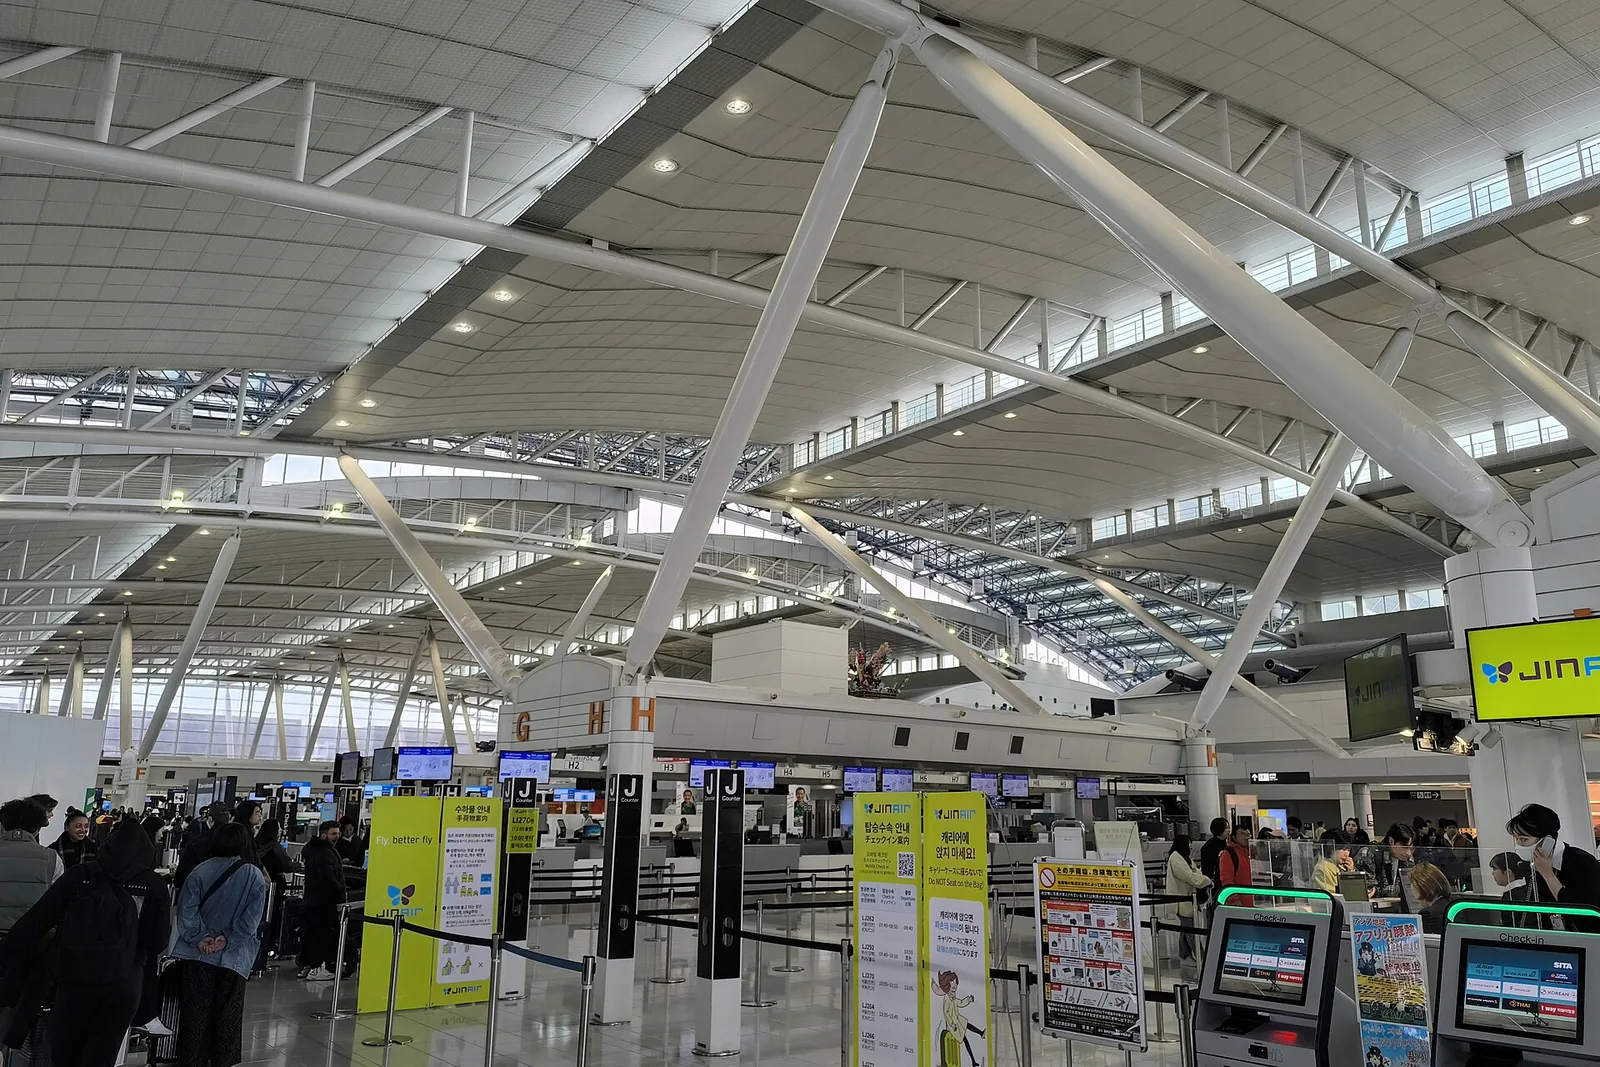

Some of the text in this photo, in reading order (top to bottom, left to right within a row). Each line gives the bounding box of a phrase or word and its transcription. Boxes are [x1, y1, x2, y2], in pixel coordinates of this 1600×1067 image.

[588, 700, 604, 735] H
[631, 696, 656, 732] H
[516, 711, 530, 742] G
[568, 761, 580, 770] H2
[664, 763, 674, 772] H3
[136, 767, 147, 780] F
[783, 768, 793, 777] H4
[505, 780, 511, 798] J
[518, 780, 531, 798] J
[609, 776, 616, 797] J
[623, 778, 636, 797] J
[706, 773, 714, 795] J
[725, 773, 738, 795] J
[348, 790, 359, 801] H
[455, 805, 491, 814] 수하물 안내
[874, 804, 912, 814] JINAIR
[943, 810, 977, 820] JINAIR
[864, 822, 910, 834] 탑승수속 안내
[376, 835, 433, 847] Fly, better fly
[865, 836, 910, 845] チェックイン案内
[941, 831, 969, 845] 캐리어에
[935, 846, 976, 860] 앉지 마세요!
[928, 877, 936, 885] Do
[936, 878, 946, 886] NOT
[946, 878, 957, 887] Seat
[964, 880, 972, 888] the
[973, 880, 984, 891] Bag!
[1253, 913, 1287, 923] Check-in
[1354, 923, 1417, 942] アフリカ豚熱
[1499, 932, 1545, 944] Check-in
[1553, 961, 1573, 969] SITA
[452, 985, 482, 994] JINAIR
